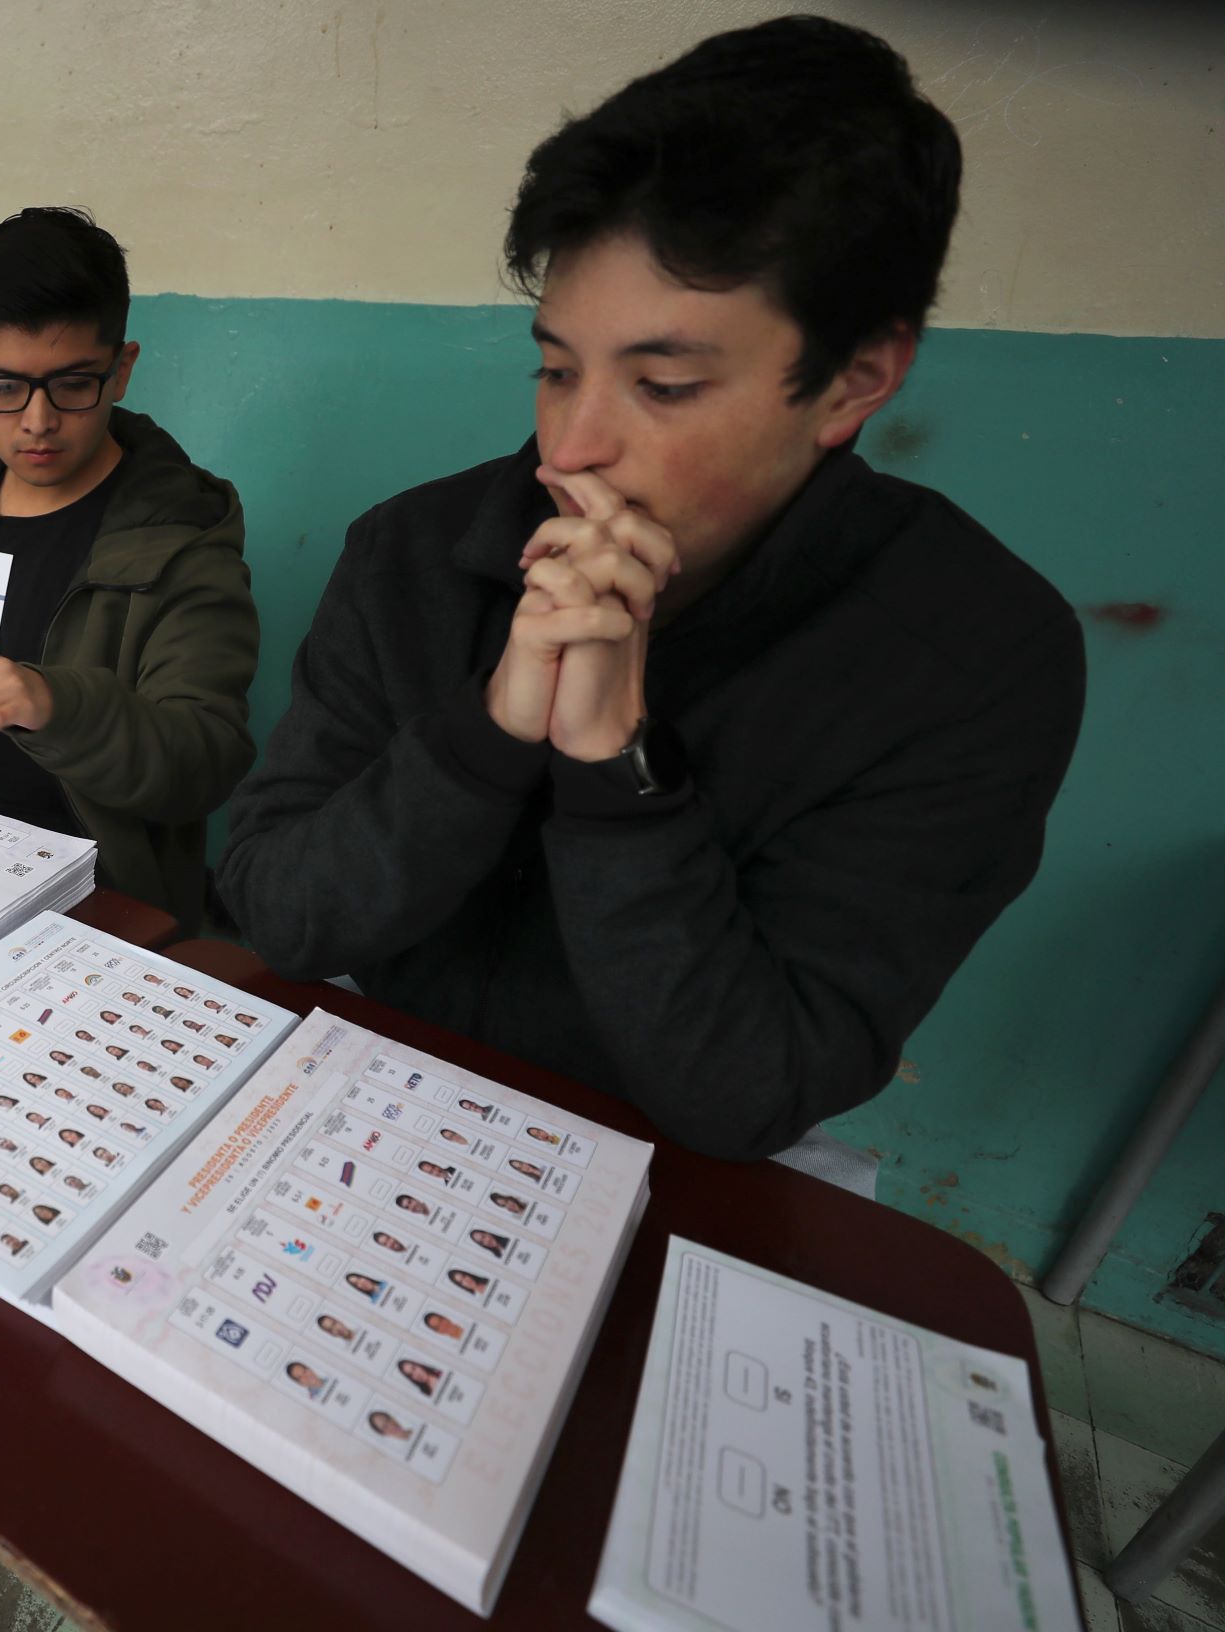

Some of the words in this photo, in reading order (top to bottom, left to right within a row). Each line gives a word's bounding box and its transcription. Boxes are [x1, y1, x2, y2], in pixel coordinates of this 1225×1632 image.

[403, 1071, 423, 1090] RETO
[186, 1143, 247, 1208] VICEPRESIDENTA
[247, 1082, 299, 1138] VICEPRESIDENTE
[187, 1141, 233, 1188] PRESIDENTA
[232, 1094, 274, 1136] PRESIDENTE
[279, 1109, 314, 1148] PRESIDENCIAL
[772, 1483, 793, 1514] NO
